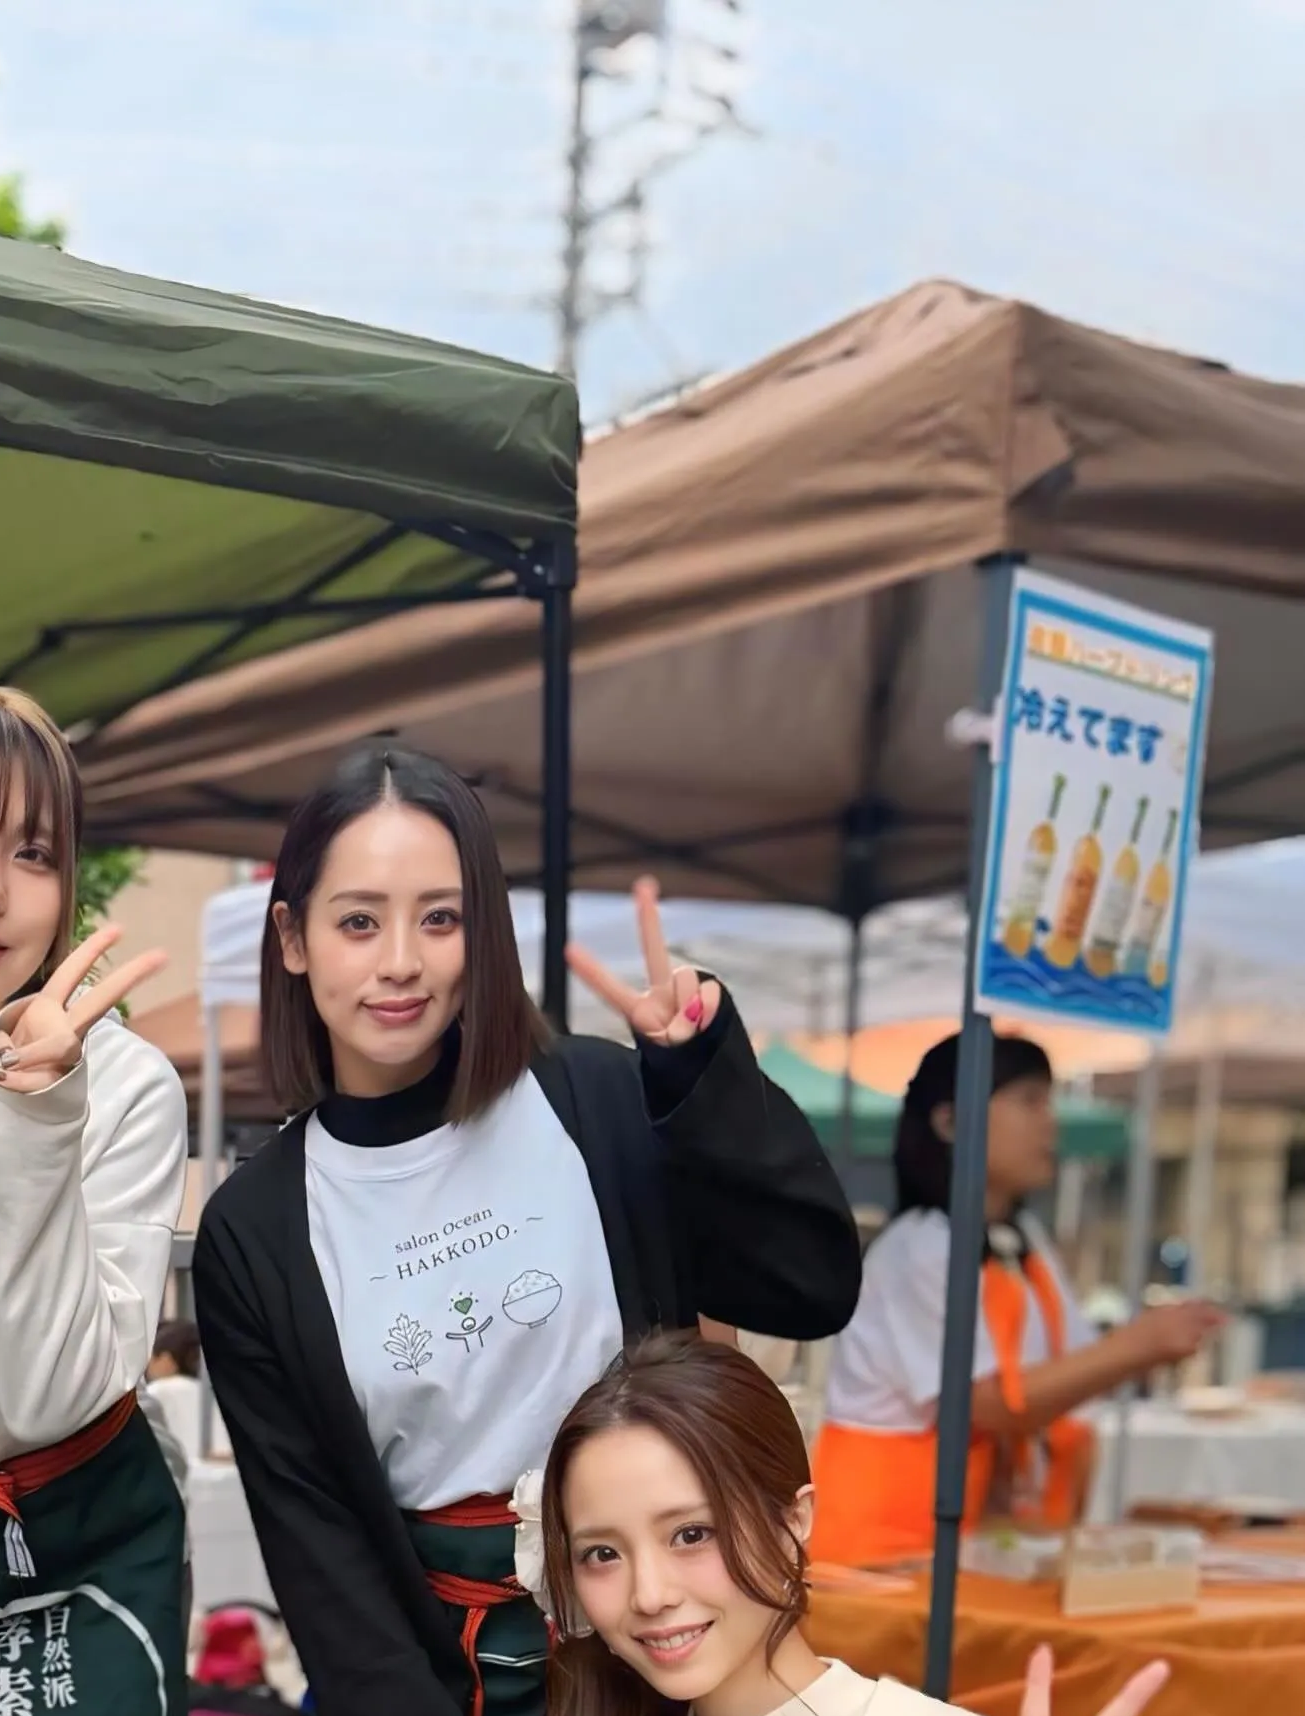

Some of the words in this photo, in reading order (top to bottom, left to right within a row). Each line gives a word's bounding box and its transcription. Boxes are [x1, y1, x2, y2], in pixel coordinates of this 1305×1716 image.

[1012, 686, 1164, 764] 冷えてます
[395, 1232, 440, 1254] salon
[442, 1208, 493, 1236] Ocean
[396, 1224, 518, 1280] HAKKODO.
[41, 1604, 77, 1709] 自然派
